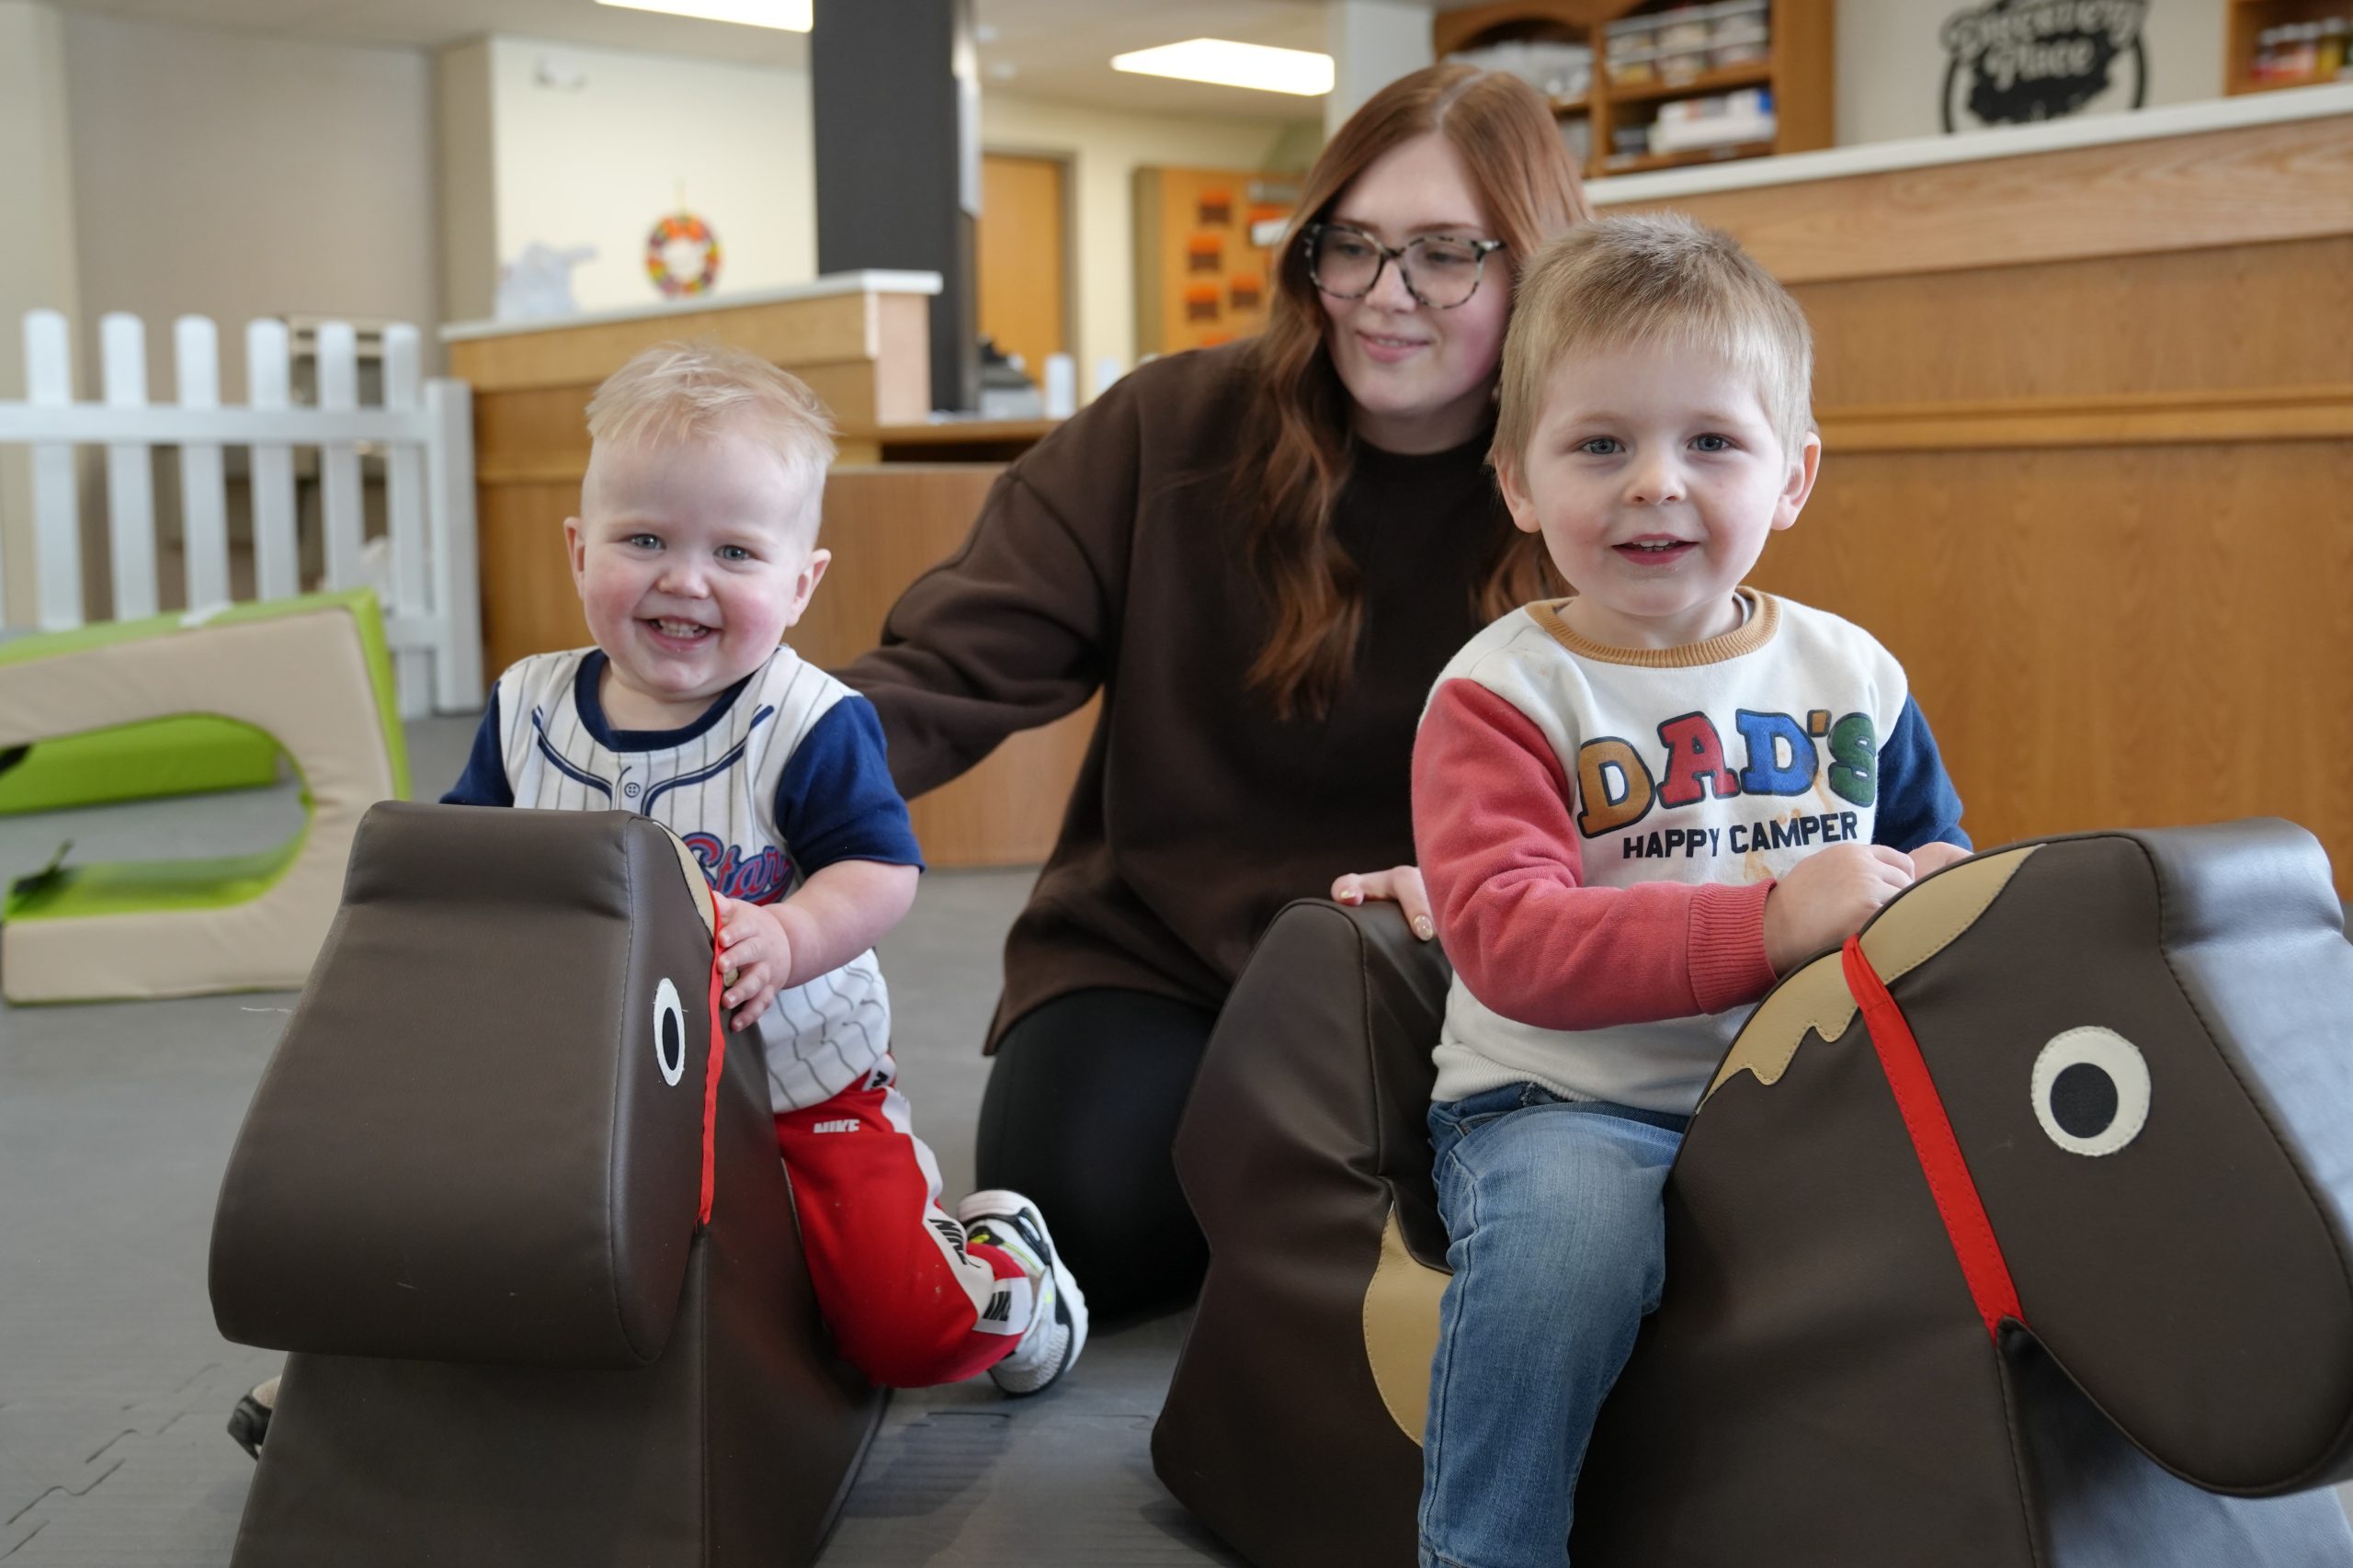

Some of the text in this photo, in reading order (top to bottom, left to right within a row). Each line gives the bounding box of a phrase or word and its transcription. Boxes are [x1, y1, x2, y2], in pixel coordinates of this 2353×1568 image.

[1984, 38, 2097, 91] Place
[1577, 708, 1877, 839] DAD'S
[1622, 811, 1858, 859] HAPPY CAMPER
